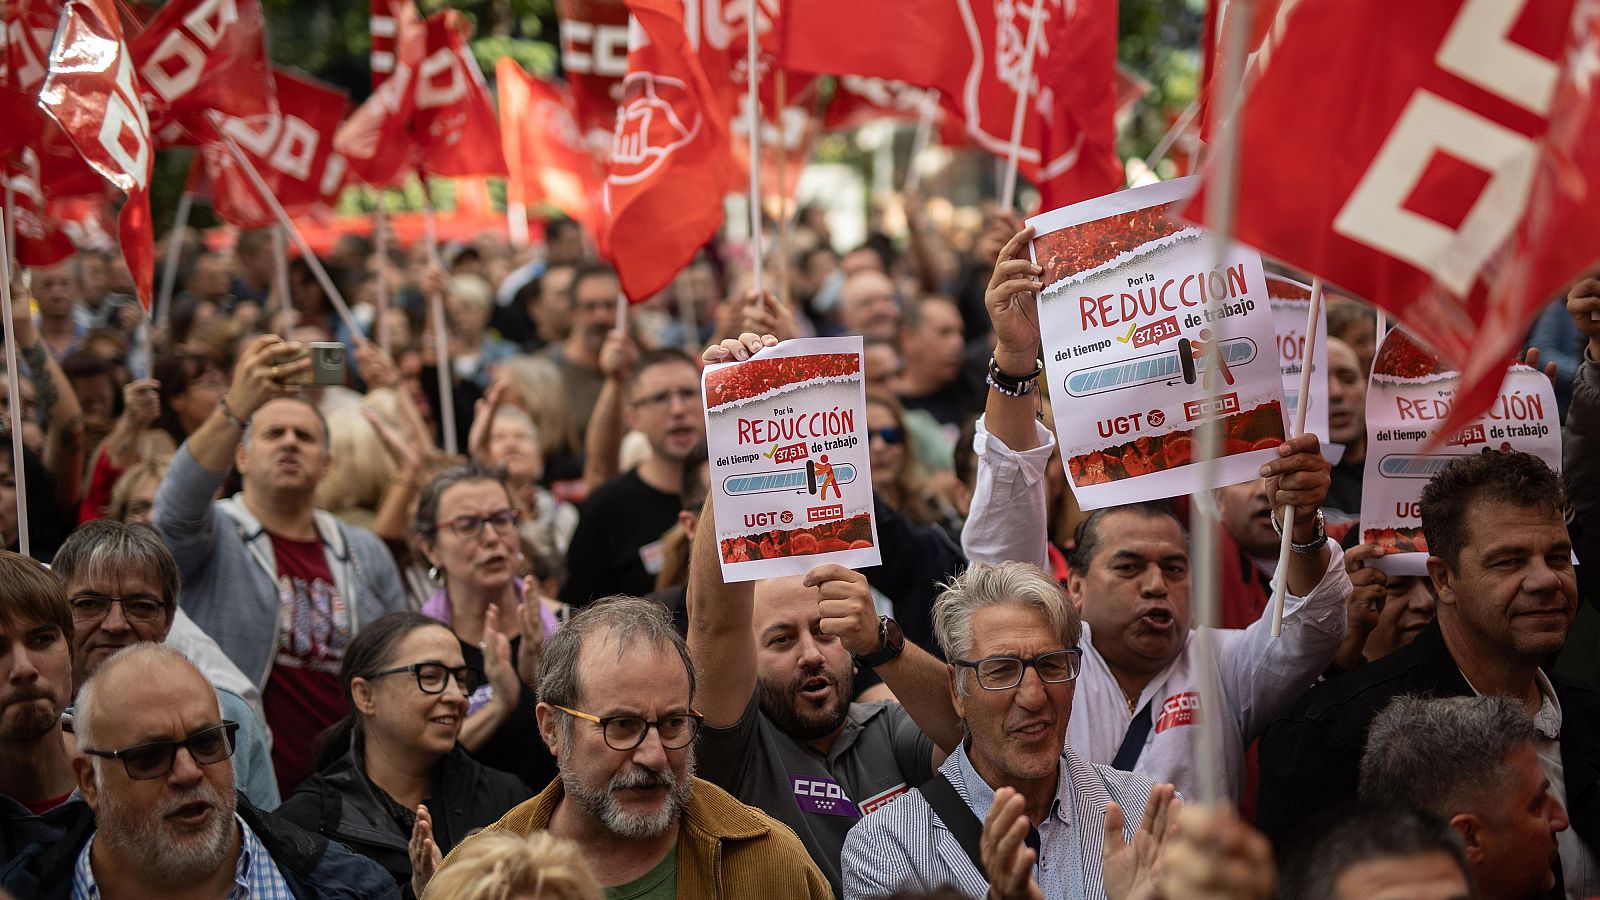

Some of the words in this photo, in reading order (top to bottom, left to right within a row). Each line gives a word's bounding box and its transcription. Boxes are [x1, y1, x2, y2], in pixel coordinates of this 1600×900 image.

[1127, 276, 1144, 288] Por
[1146, 273, 1155, 284] la
[1079, 264, 1248, 331] REDUCCIÓN
[1054, 348, 1071, 362] del
[1073, 339, 1112, 357] tiempo
[1184, 313, 1201, 328] de
[774, 408, 785, 416] Por
[787, 406, 793, 414] la
[1189, 397, 1235, 416] CCOO
[1396, 391, 1544, 420] REDCIÓN
[738, 406, 854, 445] REDUCCIÓN
[1097, 412, 1142, 438] UGT
[1377, 431, 1391, 441] del
[1393, 429, 1427, 443] tiempo
[1490, 426, 1504, 438] de
[1506, 423, 1548, 439] trabajo
[717, 454, 729, 466] del
[730, 453, 759, 465] tiempo
[811, 442, 823, 453] de
[824, 436, 858, 450] trabajo
[744, 512, 777, 527] UGT
[810, 507, 841, 518] CCOO
[1396, 502, 1421, 518] UG
